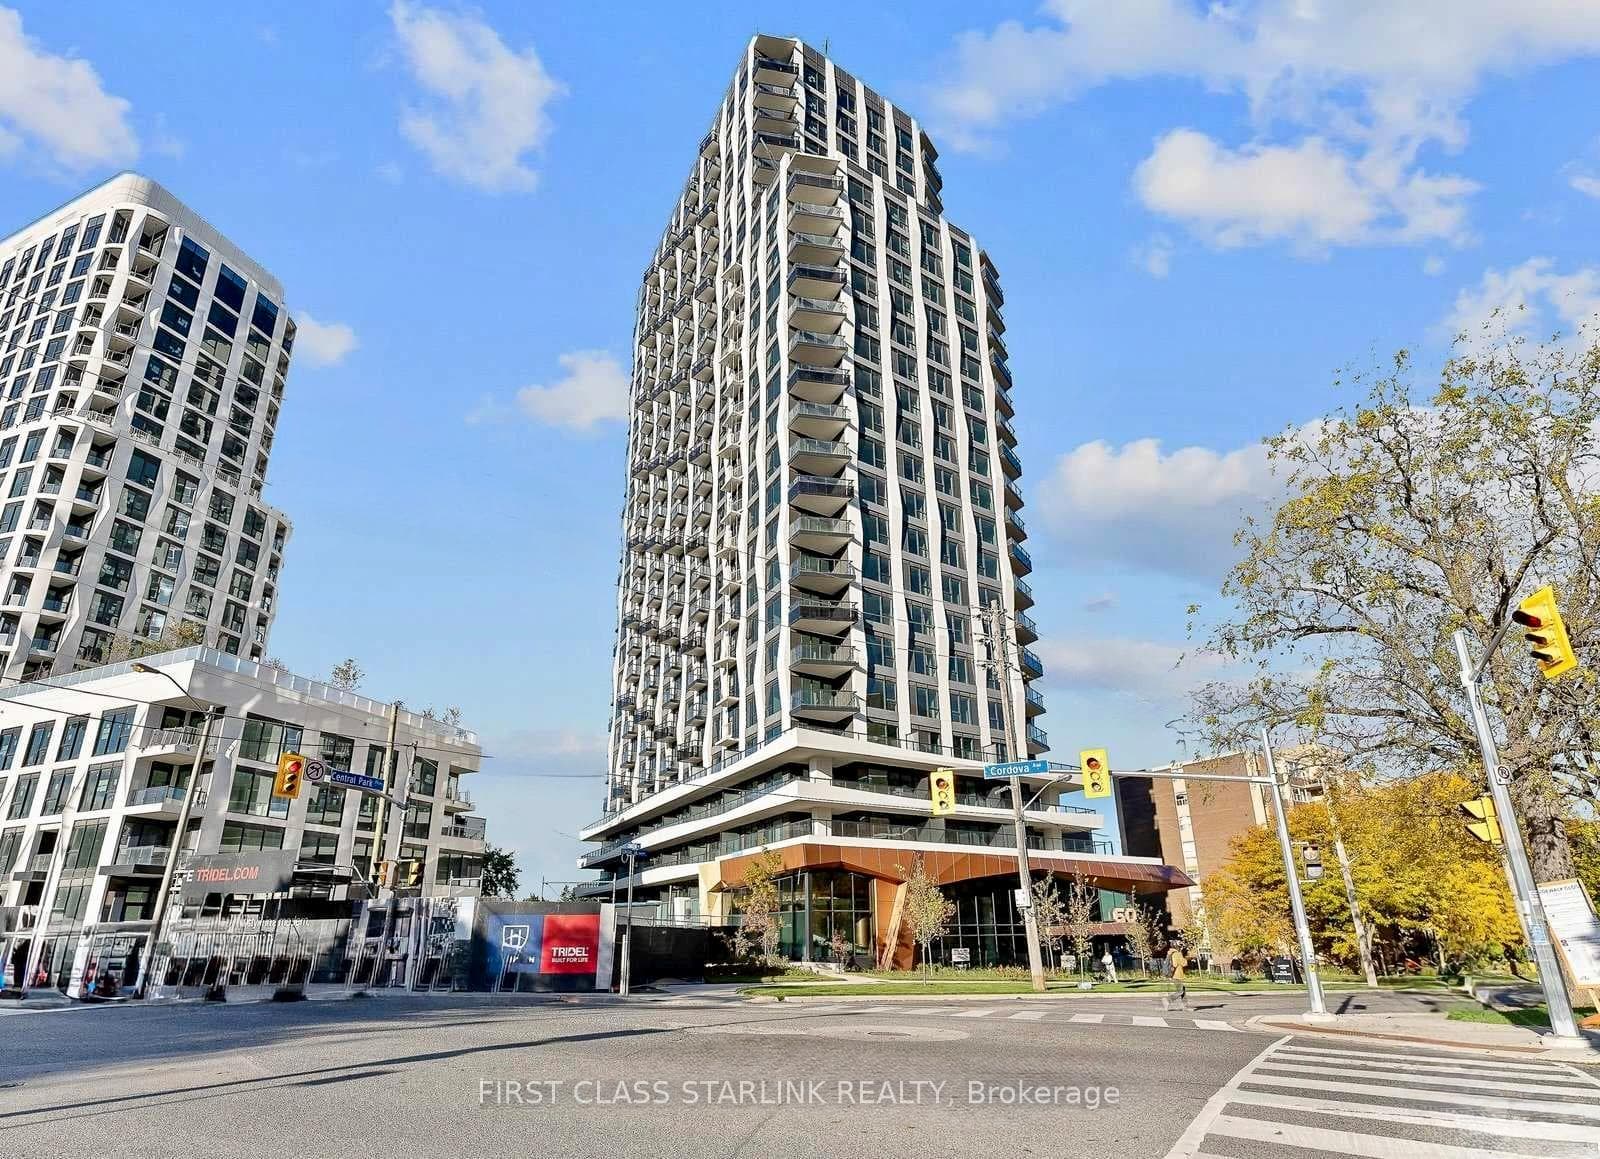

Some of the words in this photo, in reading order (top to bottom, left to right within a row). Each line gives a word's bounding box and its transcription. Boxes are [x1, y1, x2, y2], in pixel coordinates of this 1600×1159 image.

[990, 765, 1030, 776] Cordova
[331, 771, 356, 785] Central
[358, 778, 373, 788] Park
[197, 866, 259, 882] TRIDEL.COM
